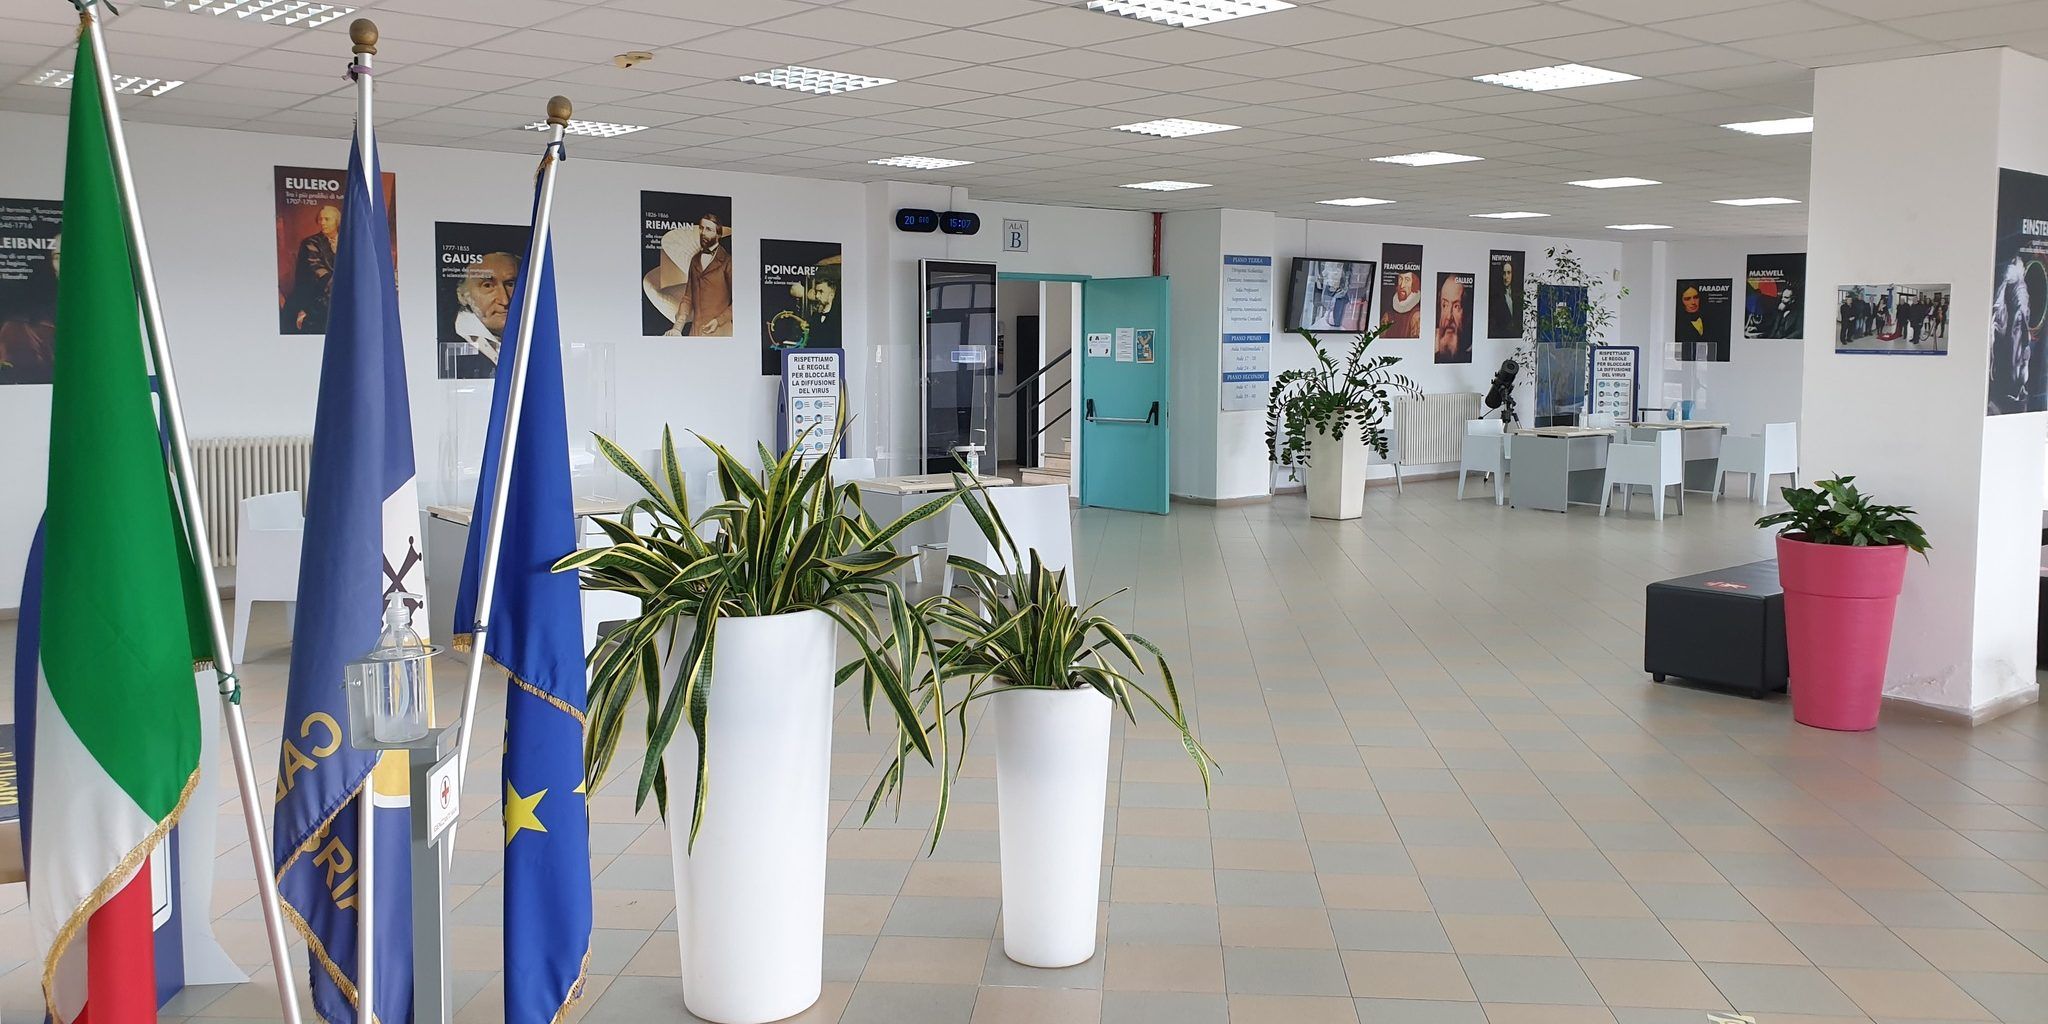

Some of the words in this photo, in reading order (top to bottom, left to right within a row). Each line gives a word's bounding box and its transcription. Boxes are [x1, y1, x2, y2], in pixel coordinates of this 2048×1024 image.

[285, 177, 340, 191] EULERO
[645, 220, 694, 230] RIEMANN
[0, 236, 57, 250] EIBNIZ
[1010, 232, 1022, 249] B
[442, 252, 484, 264] GAUSS
[764, 264, 819, 276] POINCARE'
[1748, 269, 1784, 277] MAXWELL
[1455, 276, 1473, 284] GALILEO
